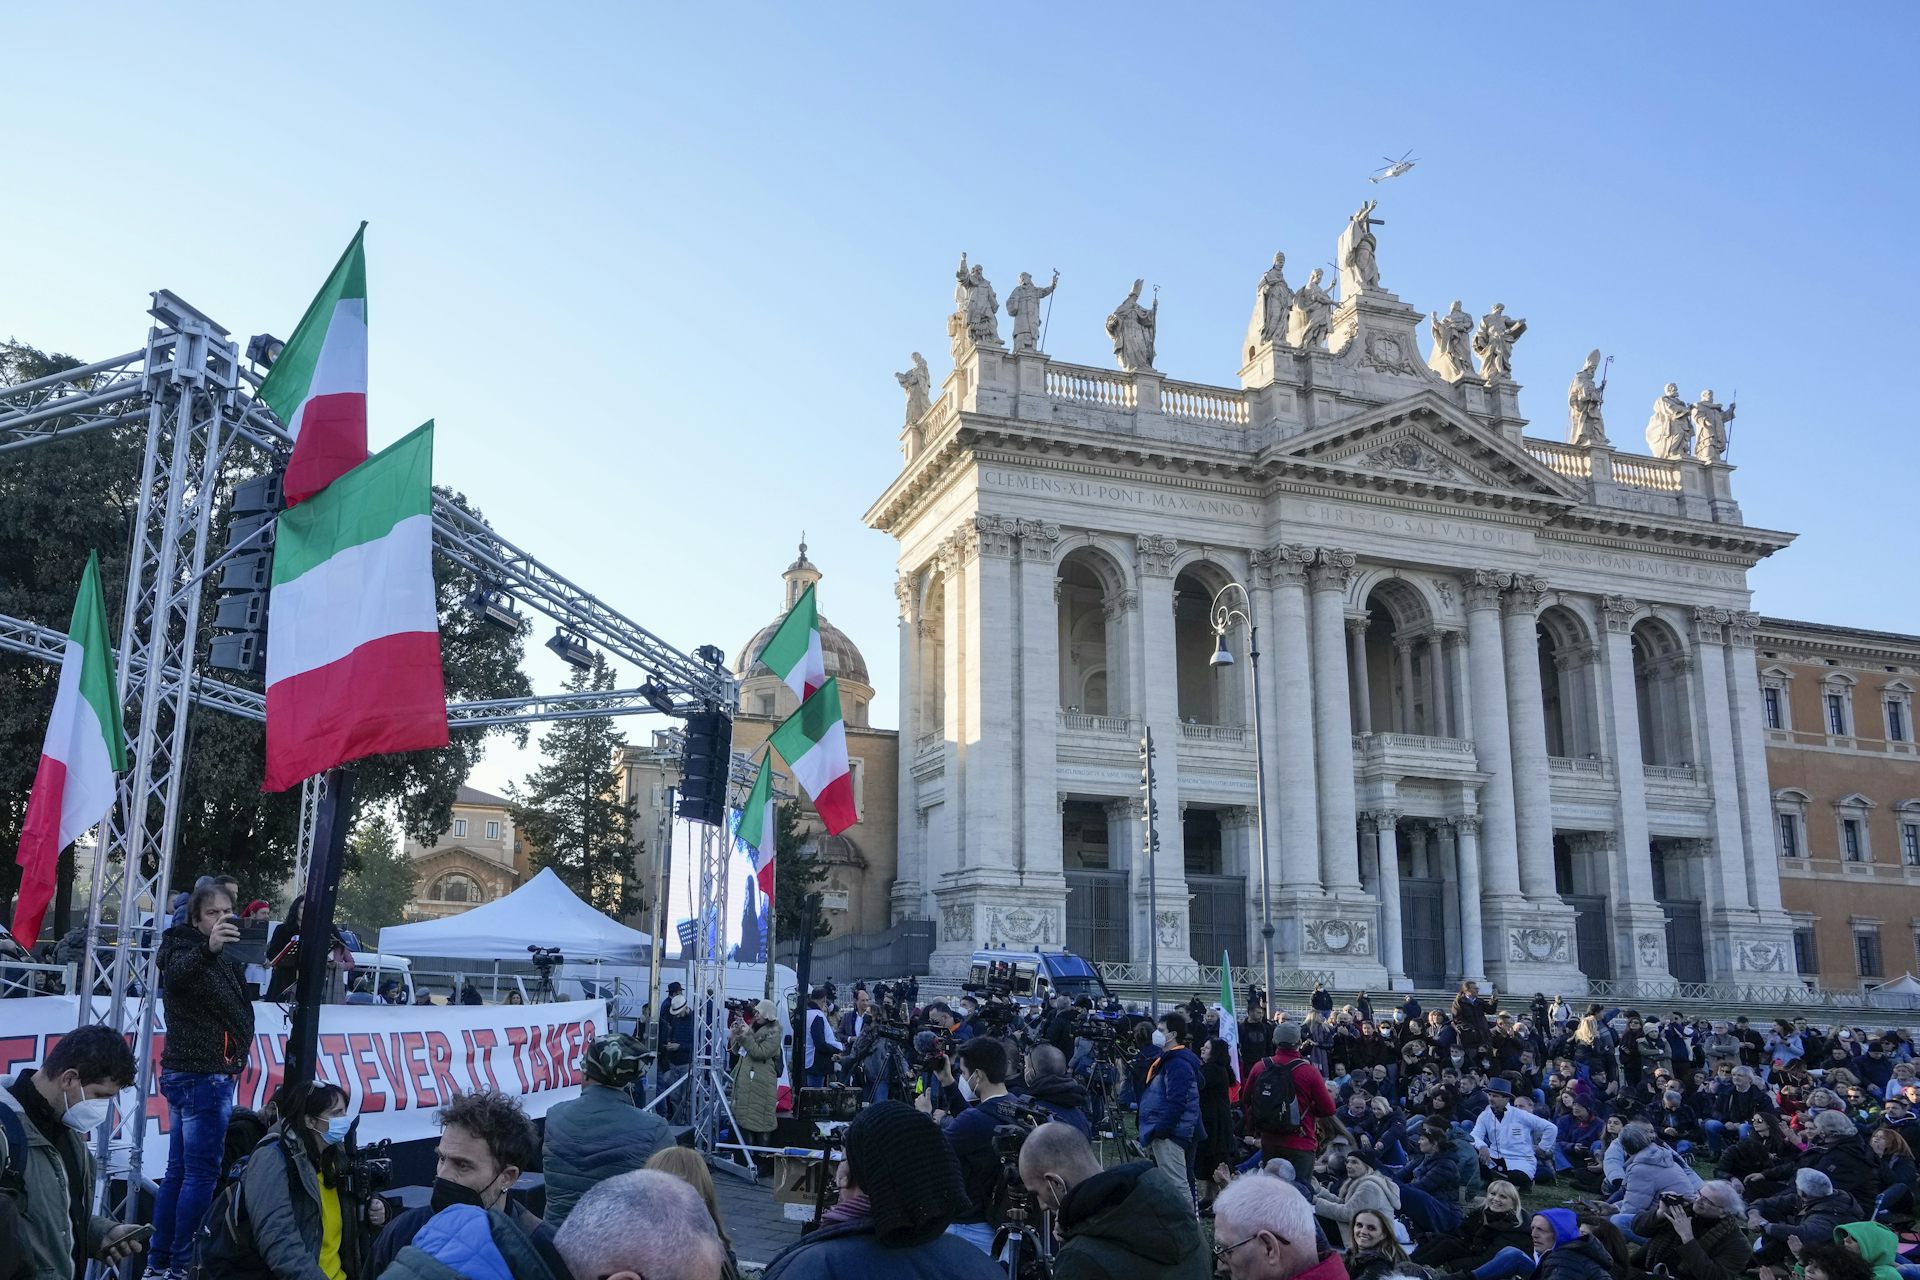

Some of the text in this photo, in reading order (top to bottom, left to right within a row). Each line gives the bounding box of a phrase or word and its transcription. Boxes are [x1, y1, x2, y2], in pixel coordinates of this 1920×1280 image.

[985, 471, 1061, 493] CLEMENS
[1068, 482, 1091, 497] XII
[1099, 486, 1145, 504] PONT
[1153, 493, 1189, 510] MAX
[1197, 501, 1244, 517] ANNO
[1304, 504, 1516, 546] CHRISTO SALVATORI
[1542, 547, 1574, 562] HON
[232, 1031, 462, 1113] WHTEVER
[461, 1029, 500, 1094] IT
